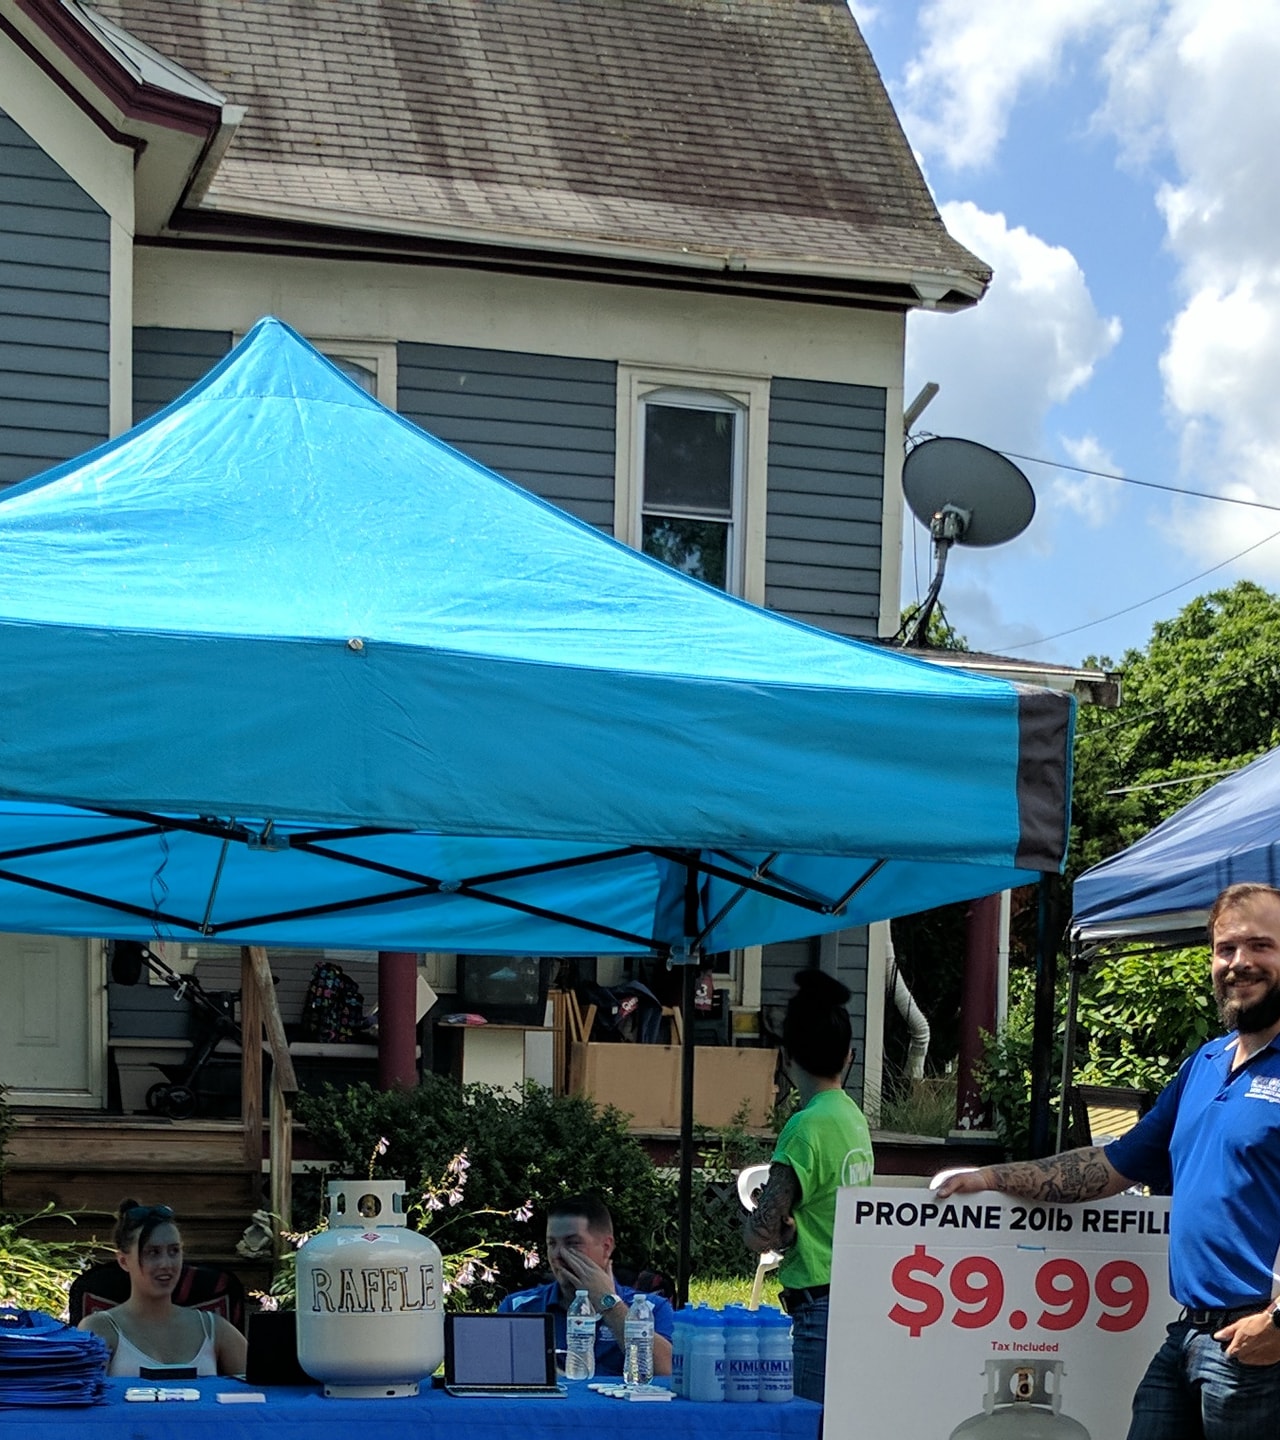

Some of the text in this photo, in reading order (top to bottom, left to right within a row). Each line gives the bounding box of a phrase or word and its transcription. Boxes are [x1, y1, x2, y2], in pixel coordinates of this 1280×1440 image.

[855, 1201, 1001, 1229] PROPANE
[1009, 1206, 1073, 1232] 20lb
[311, 1264, 436, 1313] RAFFLE
[888, 1244, 1150, 1337] $9.99
[991, 1341, 1059, 1353] Tax Included
